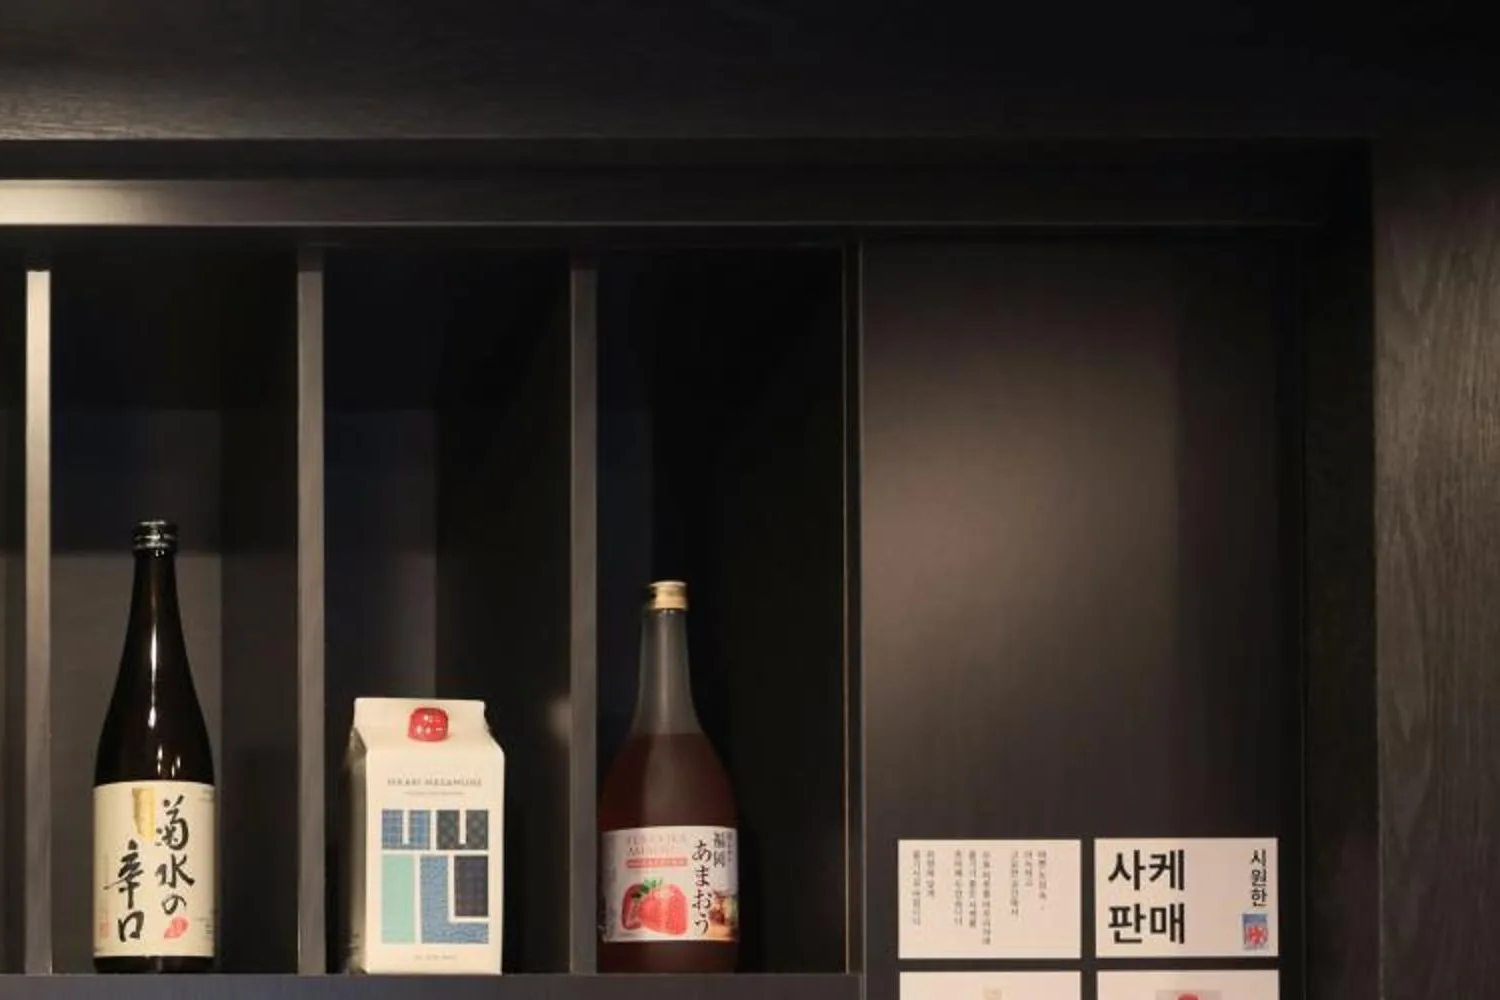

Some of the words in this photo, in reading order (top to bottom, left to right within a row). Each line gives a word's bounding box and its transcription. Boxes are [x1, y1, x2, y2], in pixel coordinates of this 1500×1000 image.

[106, 838, 145, 943] 辛口
[155, 795, 195, 916] 菊水の
[691, 839, 713, 935] あまおう
[1107, 849, 1186, 891] 사케
[1250, 849, 1268, 908] 시원한
[1107, 903, 1186, 945] 판매
